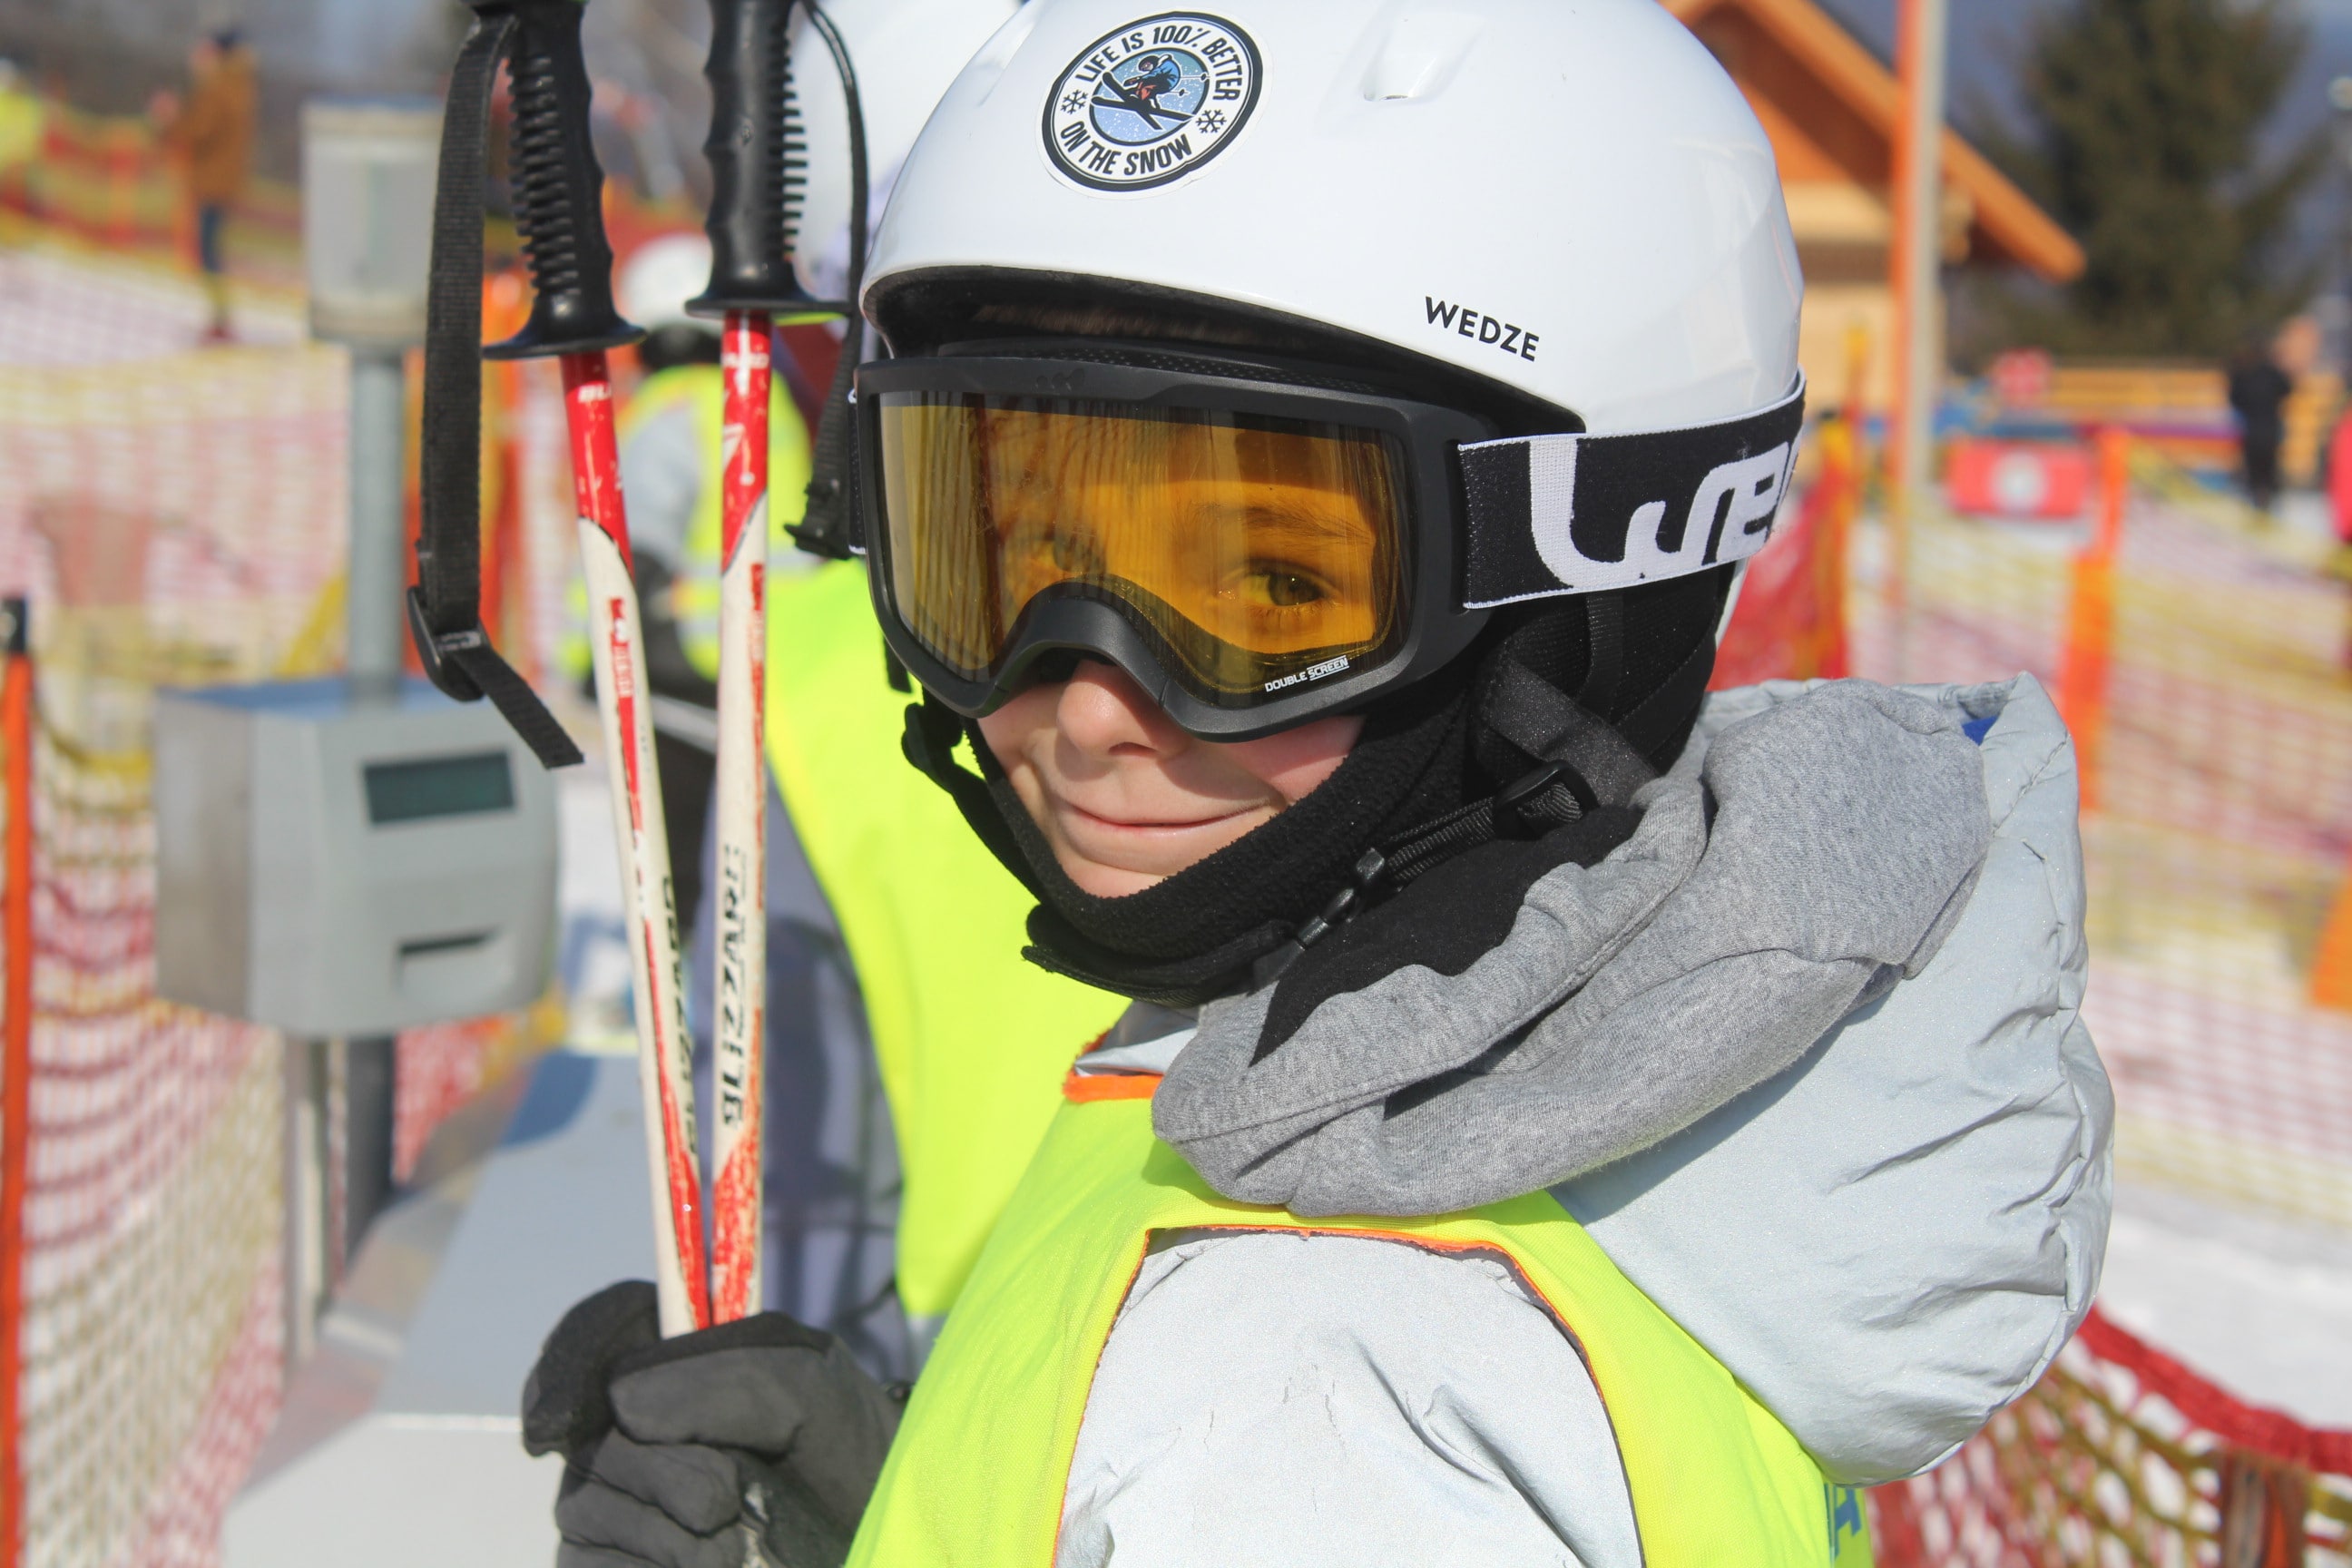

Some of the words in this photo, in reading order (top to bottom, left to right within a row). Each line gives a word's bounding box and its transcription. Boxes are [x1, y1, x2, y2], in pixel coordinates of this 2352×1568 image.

[1075, 46, 1120, 83] LIFE
[1121, 32, 1144, 53] IS
[1152, 25, 1210, 48] 100%
[1200, 37, 1243, 101] BETTER
[1060, 121, 1091, 153] ON
[1078, 141, 1122, 175] THE
[1123, 134, 1192, 176] SNOW
[1425, 296, 1540, 362] WEDZE
[1264, 671, 1308, 692] DOUBLE
[1308, 656, 1349, 679] SCREEN
